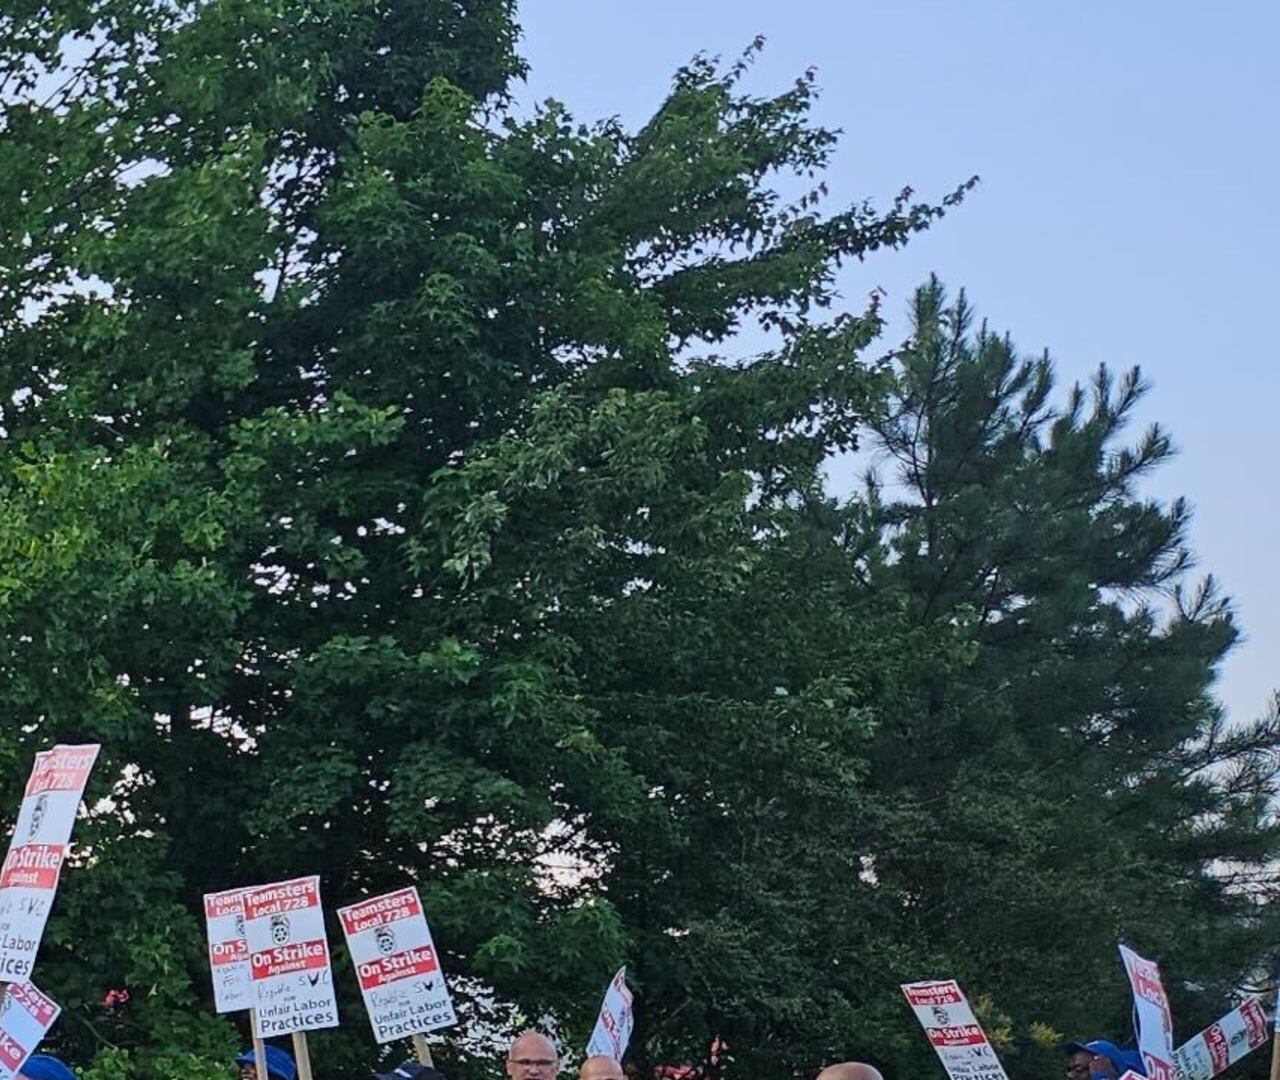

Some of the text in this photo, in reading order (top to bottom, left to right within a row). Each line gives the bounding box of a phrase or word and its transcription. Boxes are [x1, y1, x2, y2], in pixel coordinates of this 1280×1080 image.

[17, 845, 61, 869] Strike
[244, 881, 315, 907] Teamsters
[253, 896, 309, 917] Local 728
[344, 893, 415, 921] Teamsters
[354, 906, 410, 931] Local 728
[2, 934, 36, 951] Labor
[213, 943, 234, 956] On
[253, 953, 272, 967] On
[274, 943, 324, 962] Strike
[360, 950, 431, 978] On Strike
[267, 960, 307, 975] Against
[260, 998, 331, 1018] Unfair Labor
[375, 1000, 447, 1024] Unfair Labor
[261, 1012, 333, 1033] Practices
[378, 1012, 451, 1038] Practices
[929, 1026, 979, 1039] On Strike
